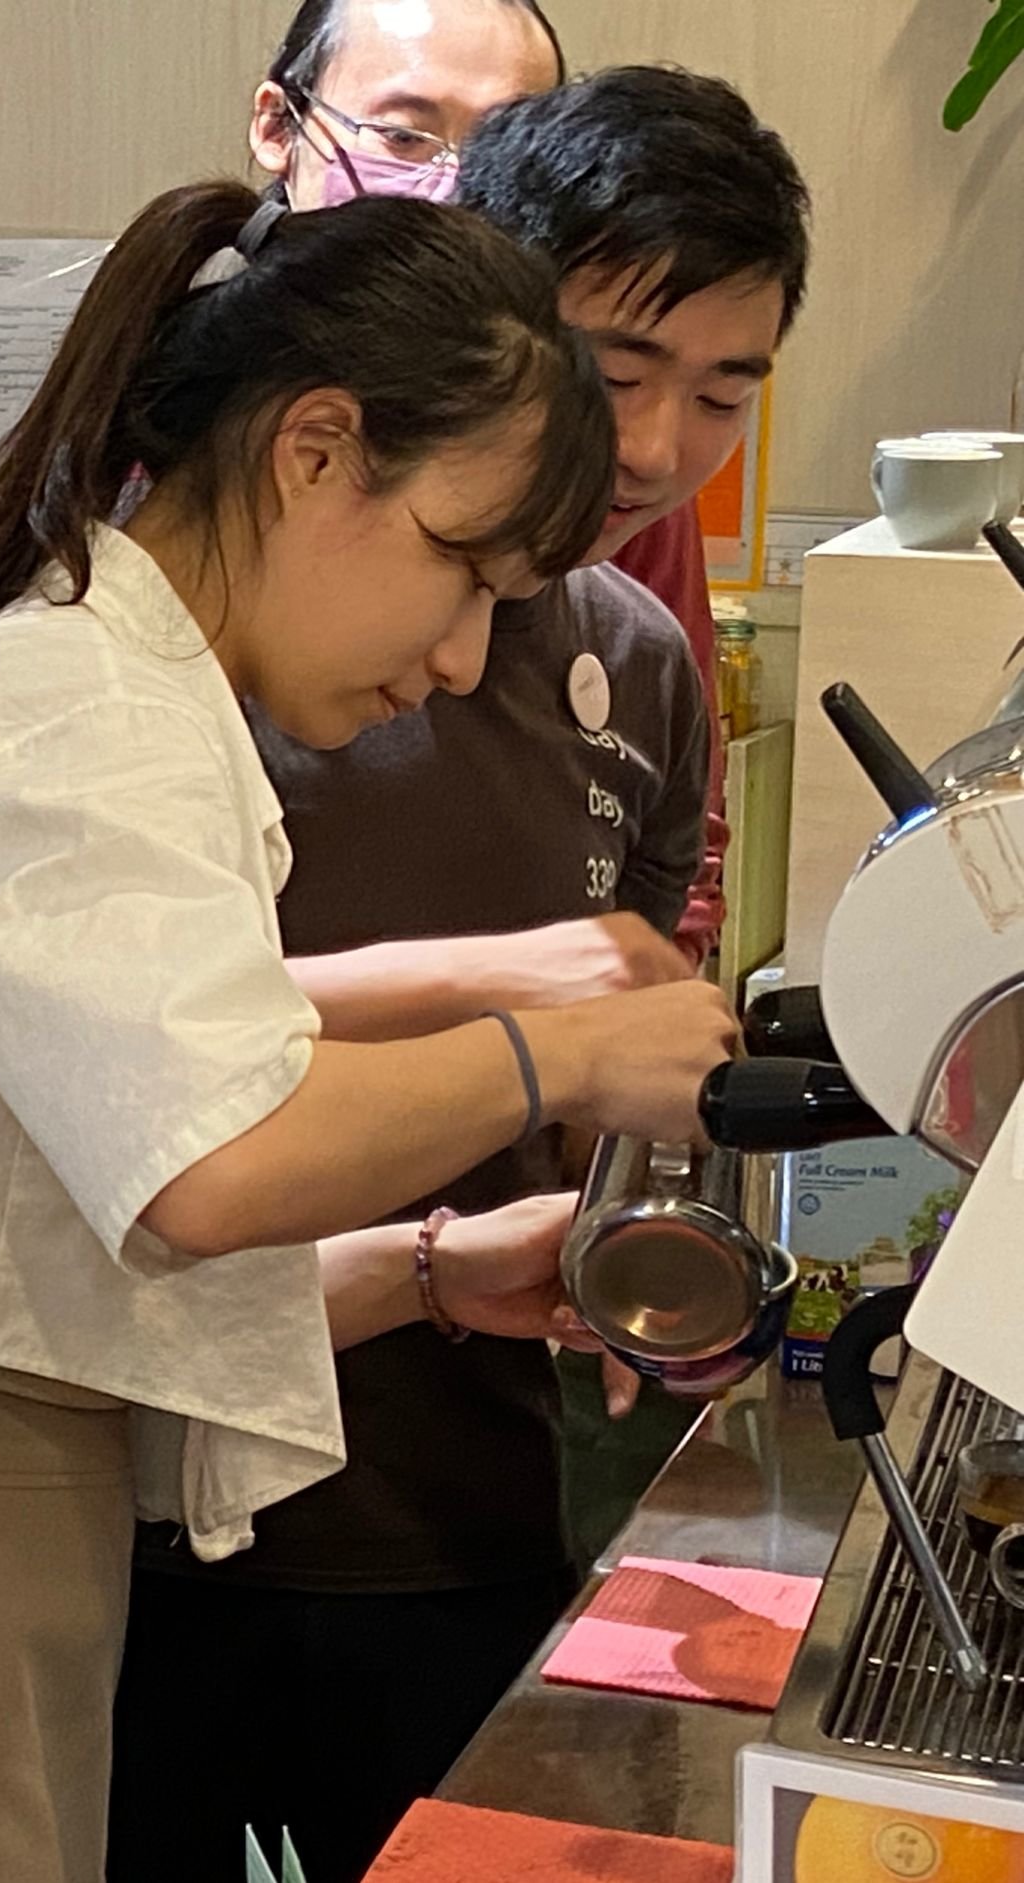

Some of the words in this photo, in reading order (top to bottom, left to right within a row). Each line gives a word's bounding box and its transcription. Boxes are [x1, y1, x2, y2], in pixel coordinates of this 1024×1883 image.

[799, 1164, 822, 1176] Full
[826, 1165, 867, 1177] Cream
[871, 1167, 898, 1178] Milk
